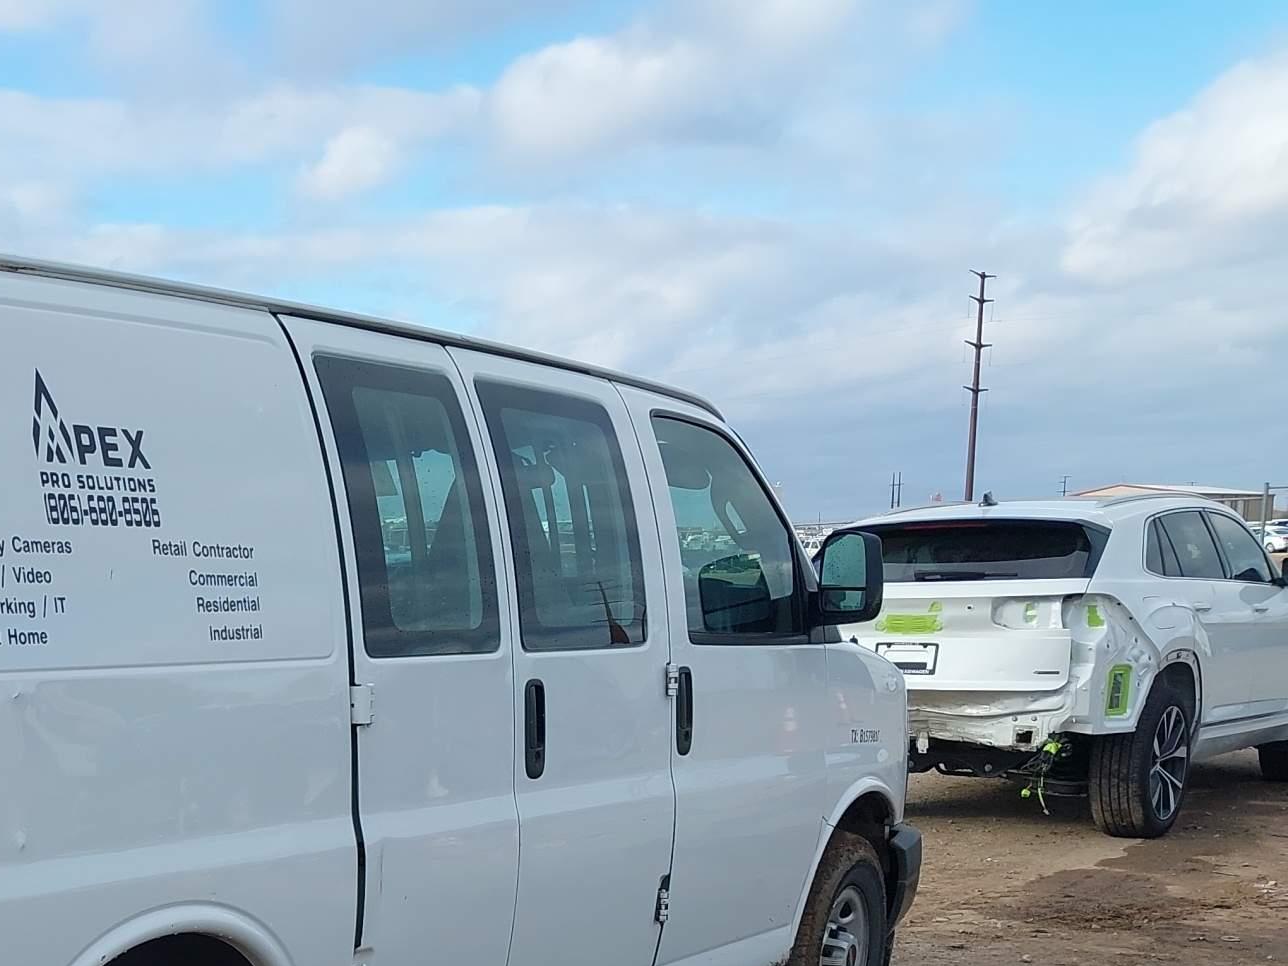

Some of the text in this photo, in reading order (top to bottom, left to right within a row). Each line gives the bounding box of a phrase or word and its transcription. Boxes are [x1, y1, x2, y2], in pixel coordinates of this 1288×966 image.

[33, 367, 151, 470] APEX
[40, 471, 156, 493] PRO SOLUTIONS
[44, 493, 161, 528] (806)-680-8506
[11, 536, 73, 555] Cameras
[151, 538, 255, 560] Retail Contractor
[12, 566, 52, 584] Video
[188, 569, 258, 588] Commercial
[53, 596, 66, 614] IT
[196, 595, 261, 613] Residential
[7, 628, 48, 646] Home
[209, 624, 263, 642] Industrial
